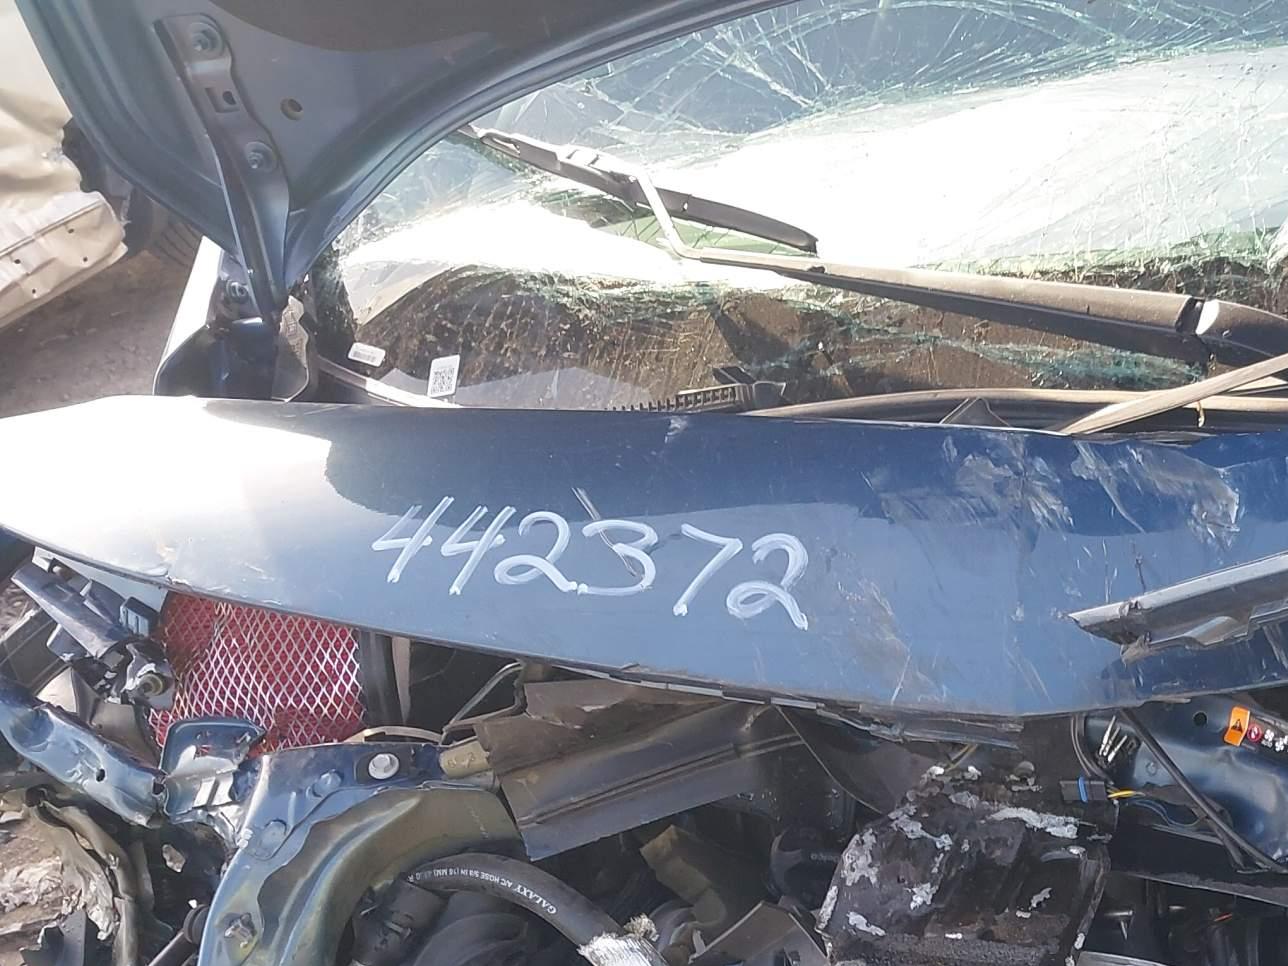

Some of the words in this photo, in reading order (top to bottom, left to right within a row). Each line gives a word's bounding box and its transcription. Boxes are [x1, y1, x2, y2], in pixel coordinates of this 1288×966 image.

[371, 496, 808, 631] 442372
[480, 871, 500, 884] HOSE
[512, 884, 557, 915] GALAXY
